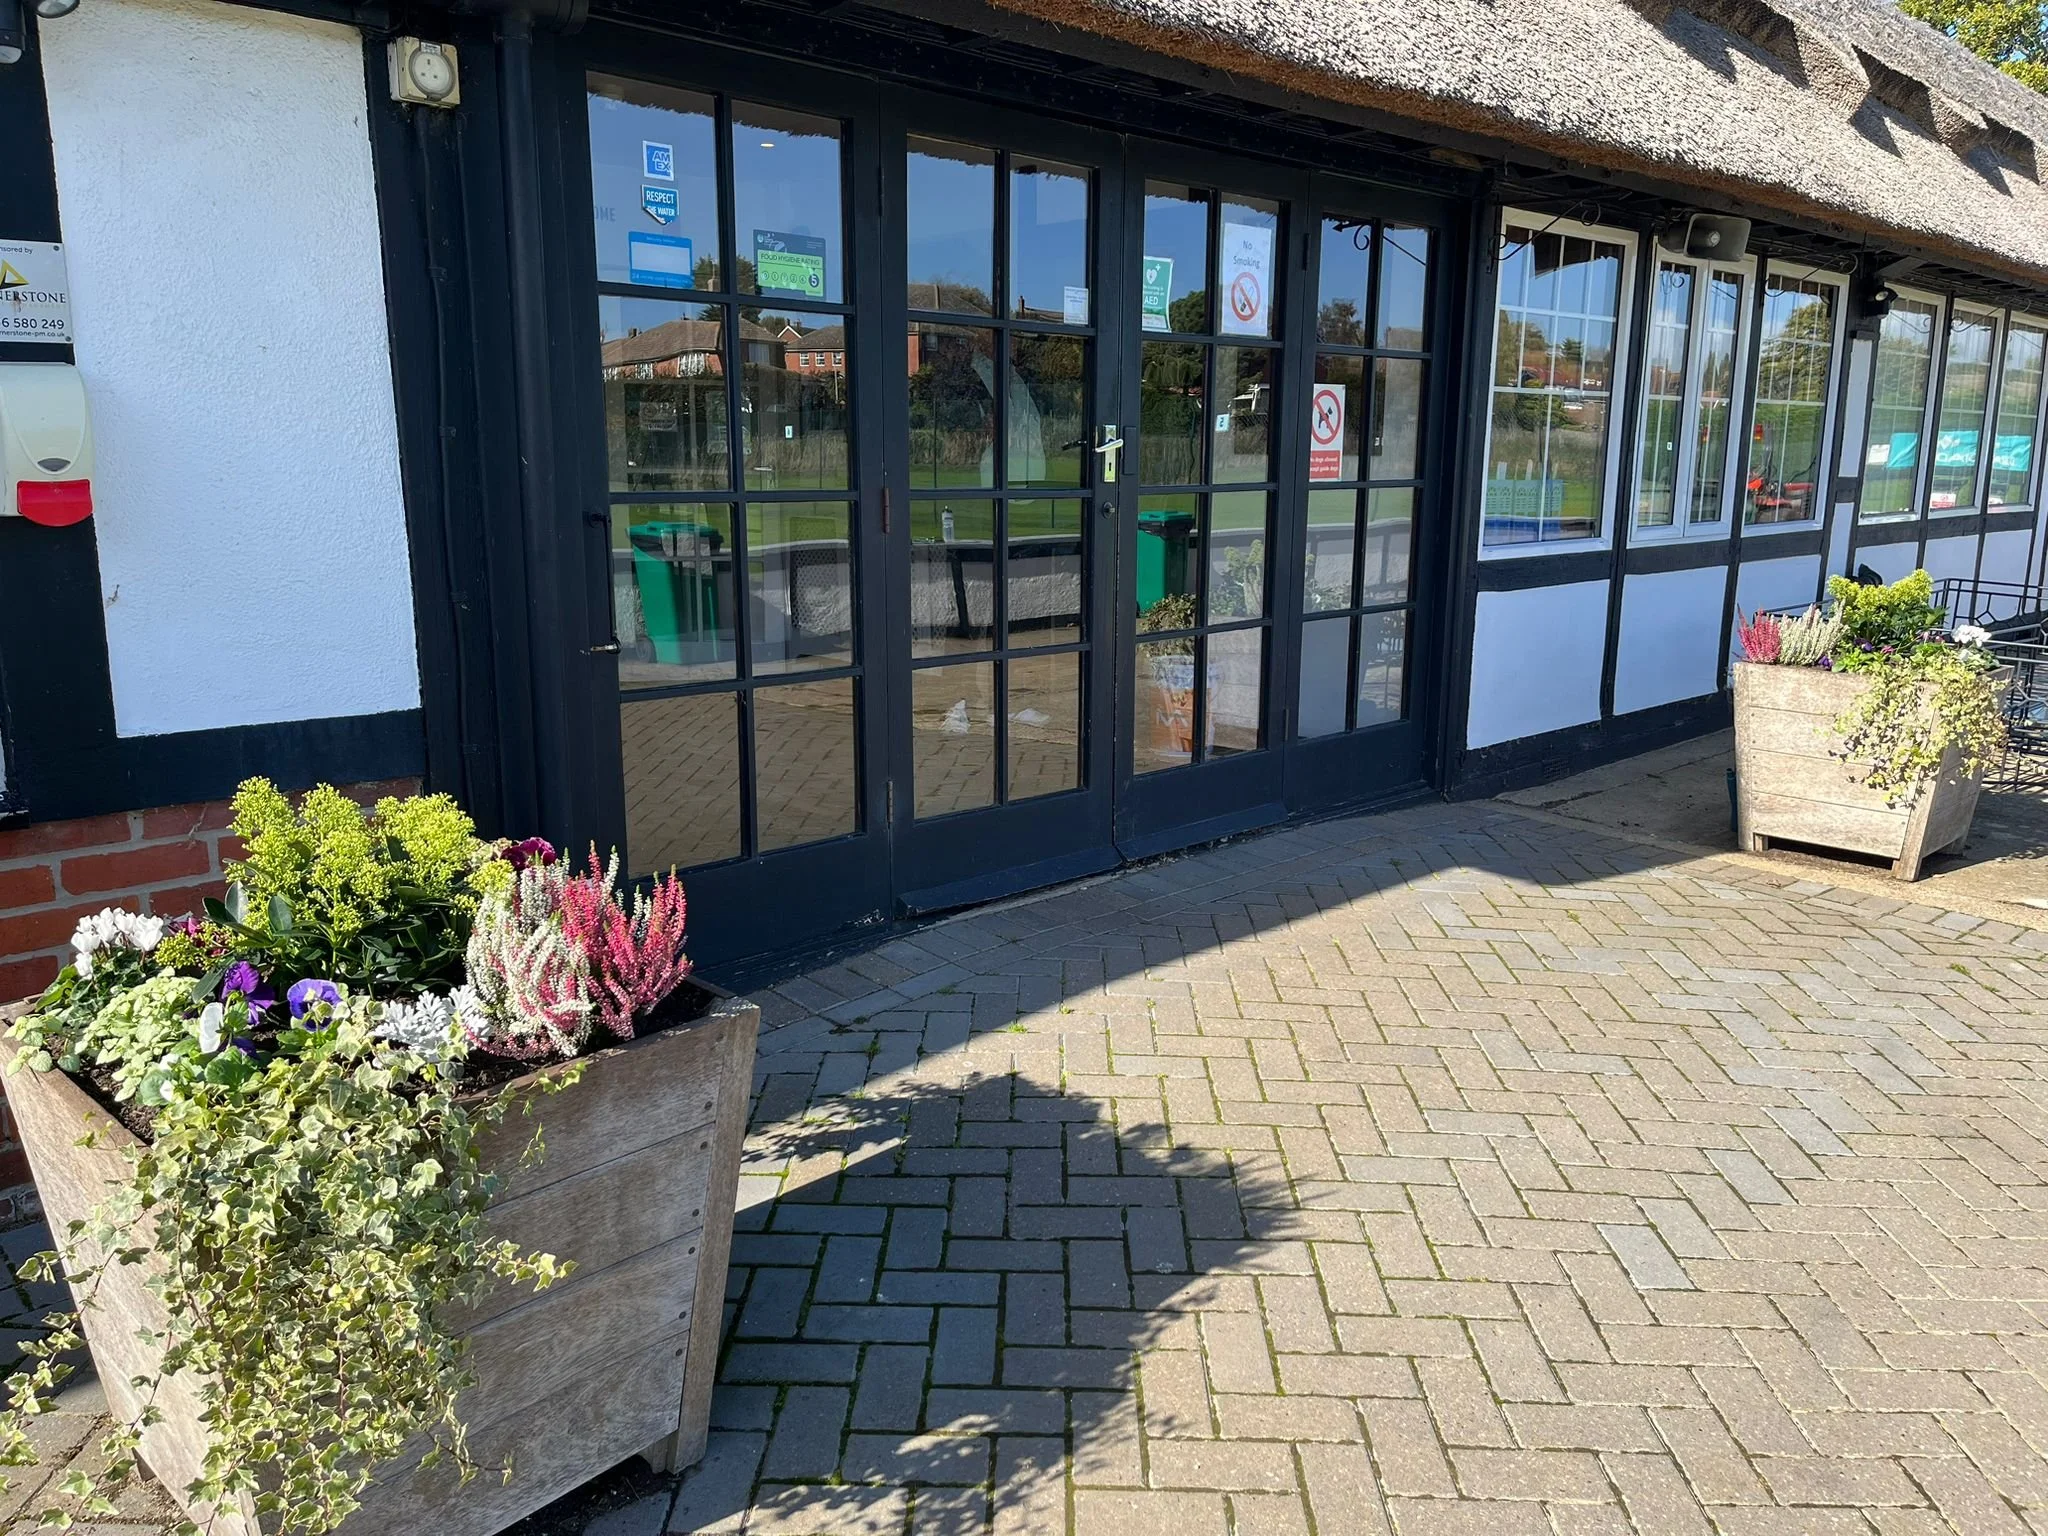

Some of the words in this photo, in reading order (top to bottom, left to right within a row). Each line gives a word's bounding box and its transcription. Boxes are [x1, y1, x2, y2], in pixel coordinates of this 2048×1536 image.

[646, 190, 675, 205] RESPECT
[657, 206, 676, 217] WATER
[1242, 240, 1252, 250] No
[24, 247, 33, 255] by
[761, 253, 778, 261] FOOD
[1233, 255, 1260, 270] Smoking
[811, 275, 817, 287] 5
[1144, 296, 1159, 305] AED
[13, 318, 37, 329] 580
[41, 319, 65, 330] 249
